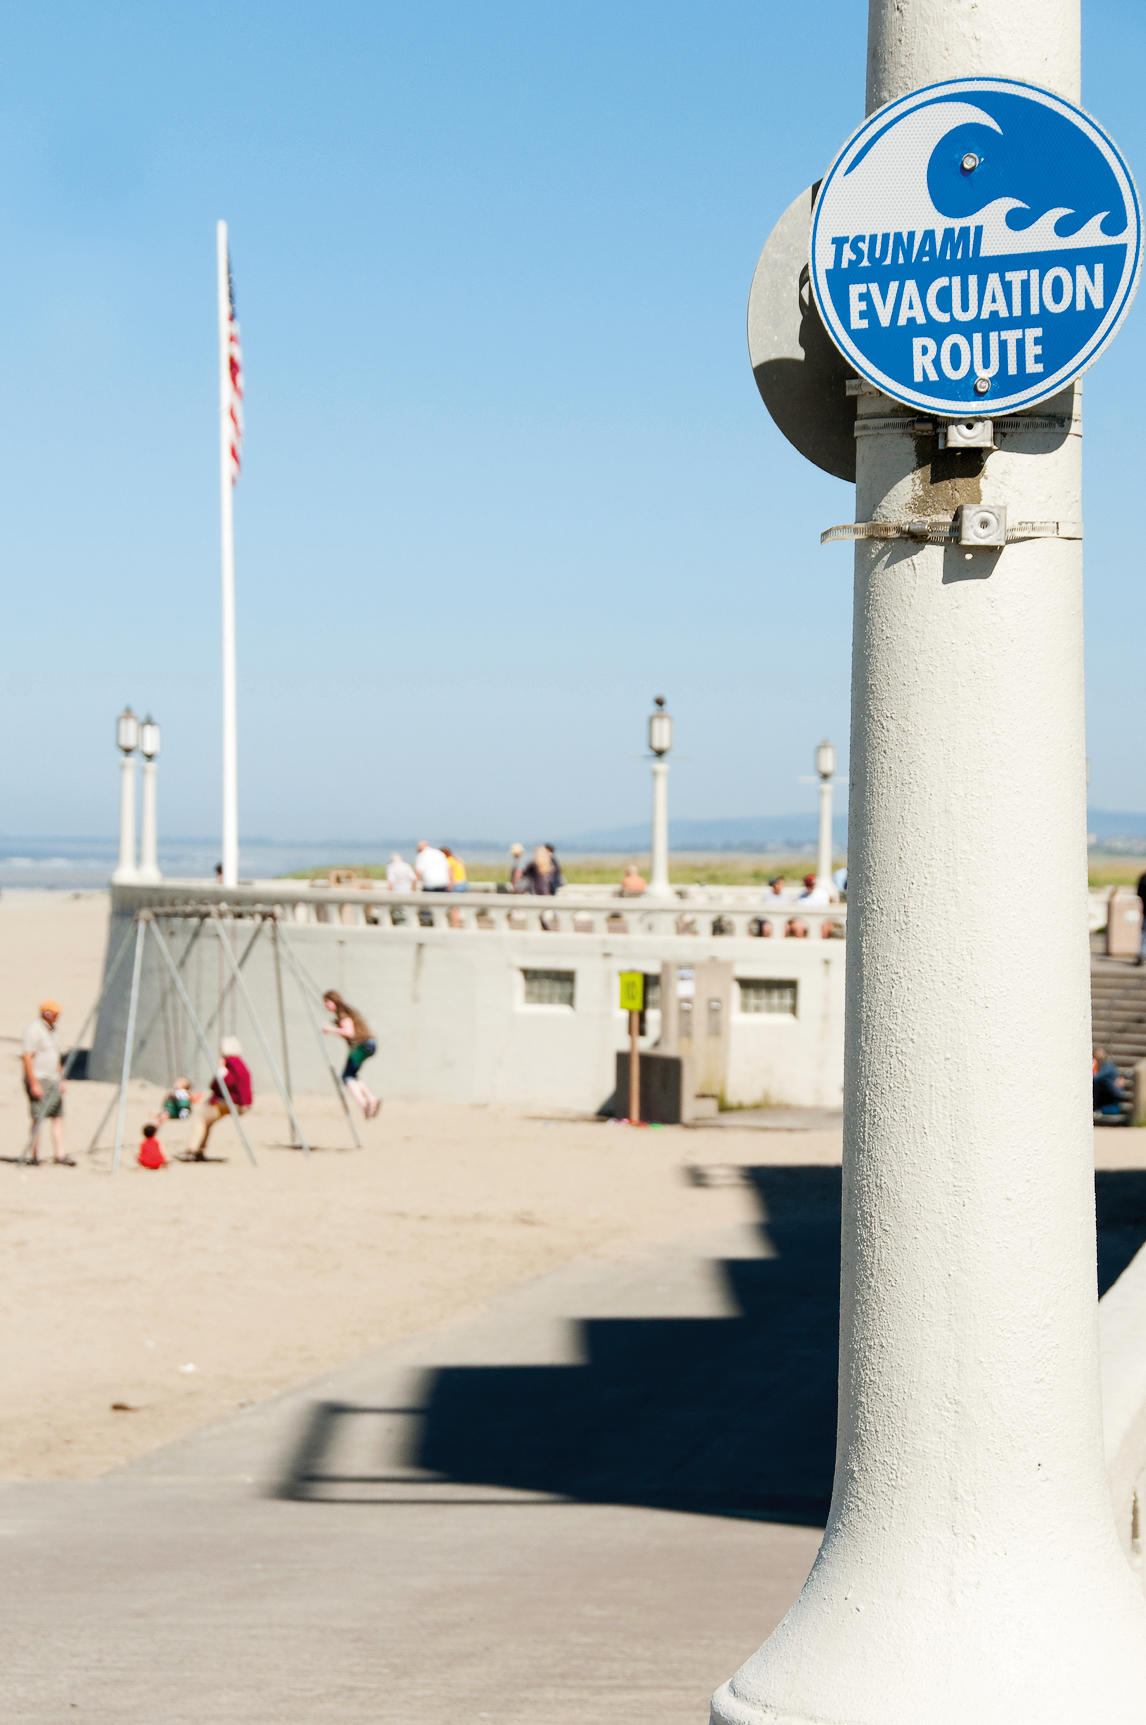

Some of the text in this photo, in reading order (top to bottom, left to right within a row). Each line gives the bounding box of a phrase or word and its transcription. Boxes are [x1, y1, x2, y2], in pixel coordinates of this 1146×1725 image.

[830, 225, 984, 269] TSUNAMI
[849, 263, 1104, 330] EVACUATION
[912, 328, 1044, 382] ROUTE
